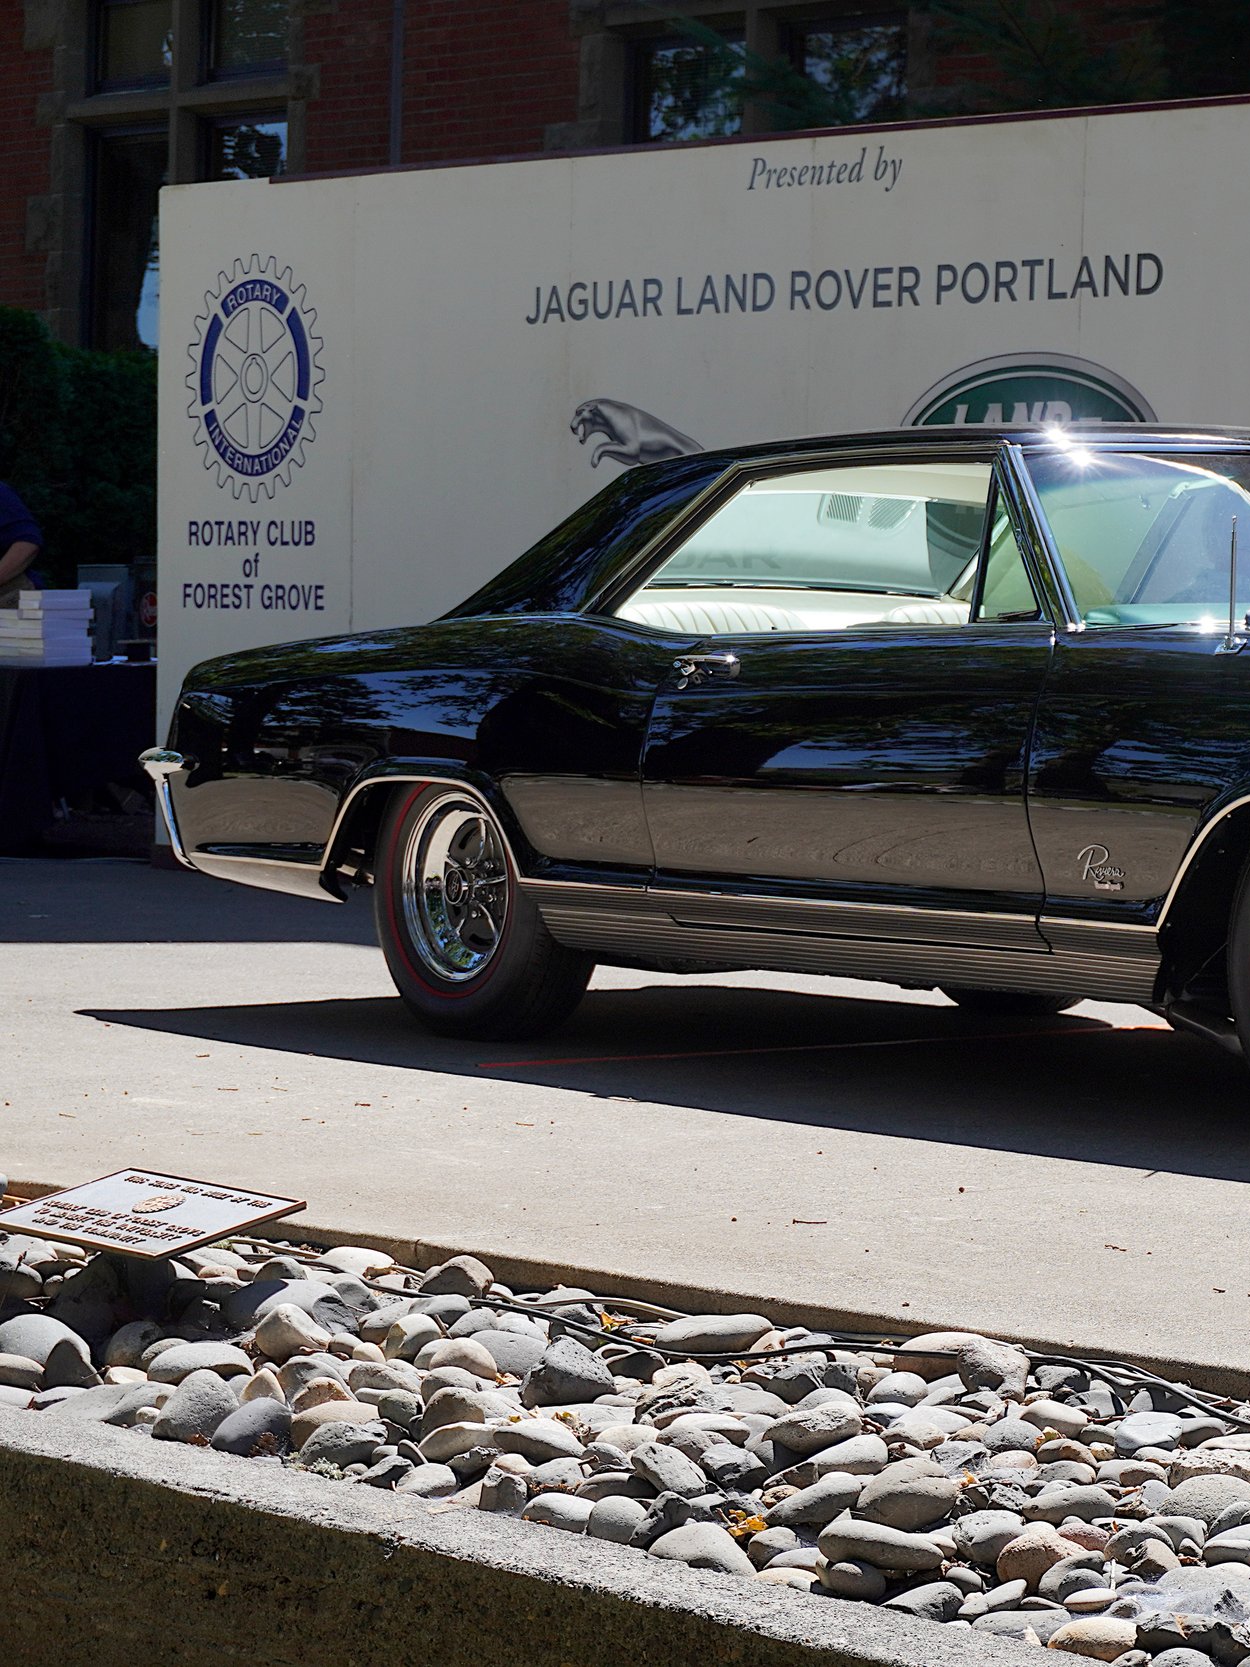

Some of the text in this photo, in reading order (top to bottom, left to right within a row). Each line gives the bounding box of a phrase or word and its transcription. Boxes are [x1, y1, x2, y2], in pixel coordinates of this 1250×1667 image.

[747, 146, 902, 192] Presented by
[226, 284, 281, 311] ROTARY
[526, 253, 1163, 324] JAGUAR LAND ROVER PORTLAND
[209, 419, 303, 475] INTERNATIONAL
[188, 520, 315, 546] ROTARY CLUB
[242, 552, 259, 577] of
[183, 583, 325, 611] FOREST GROVE
